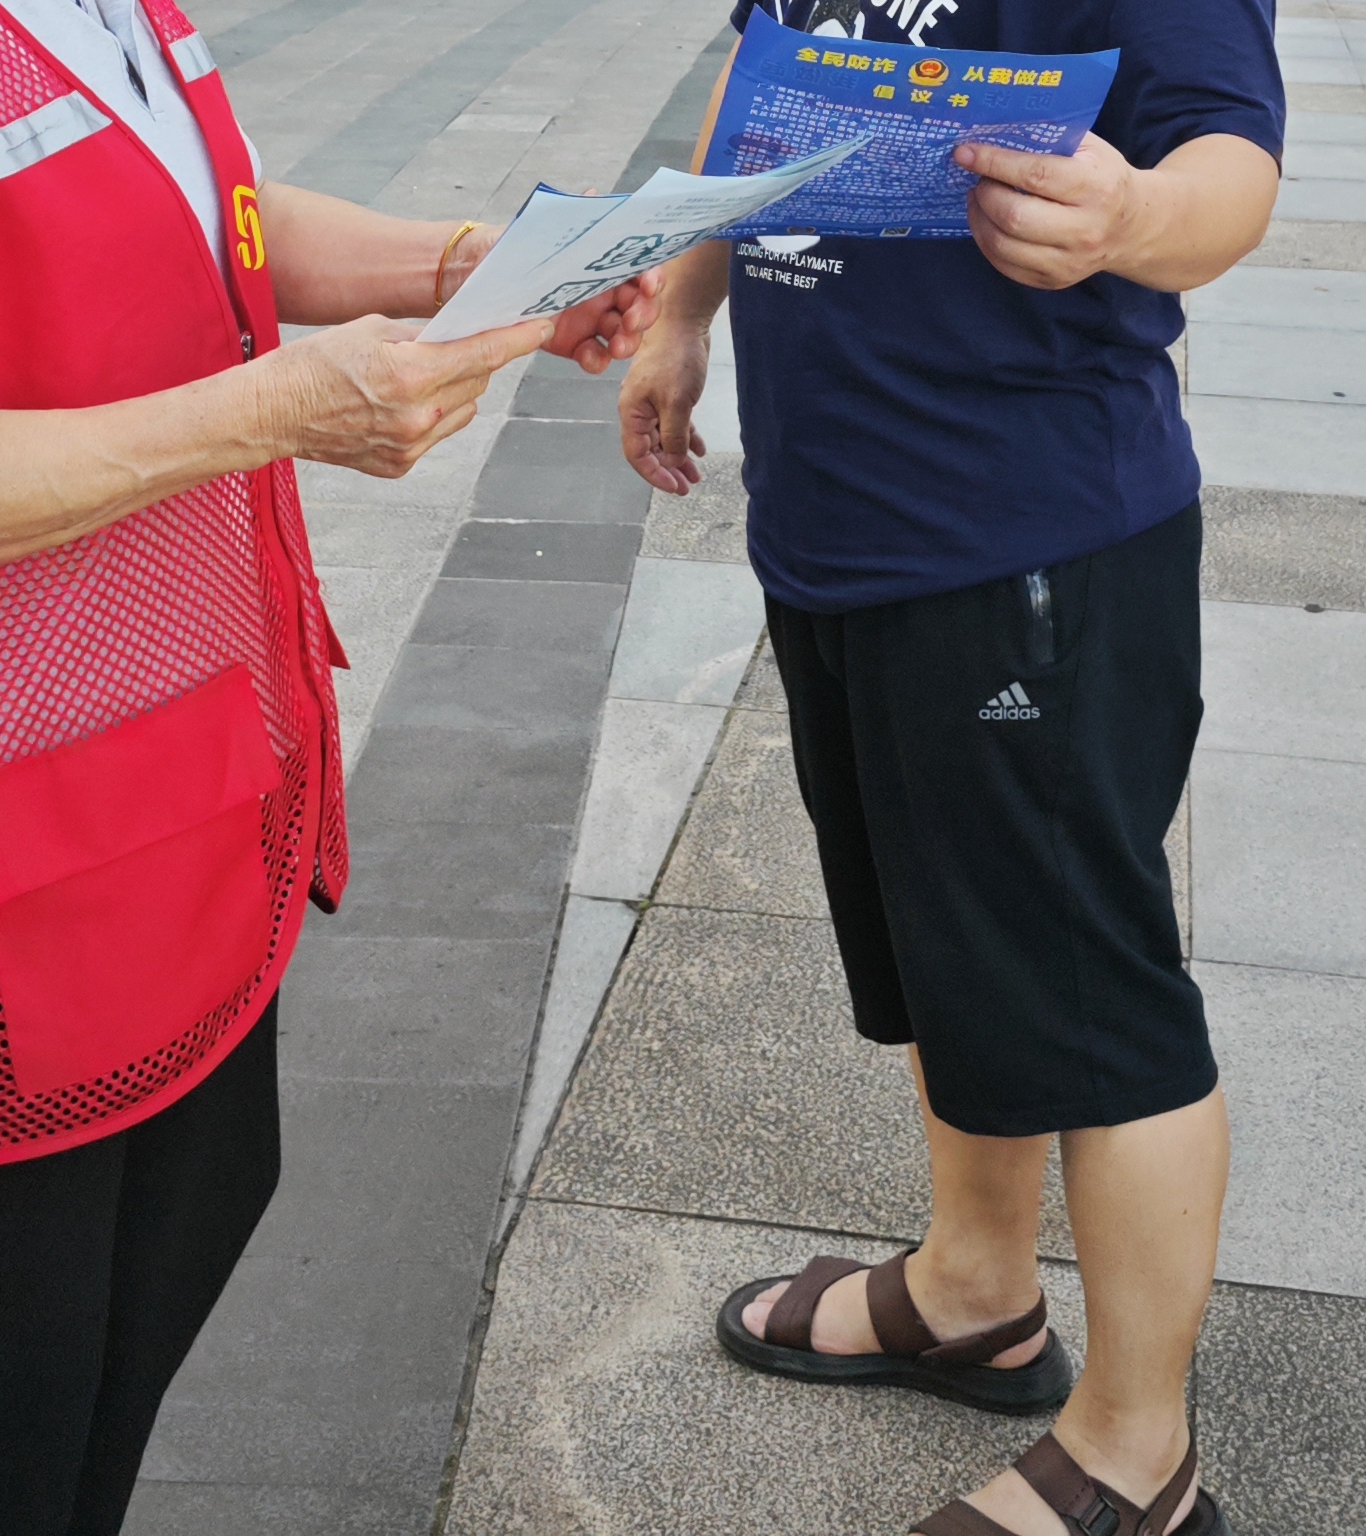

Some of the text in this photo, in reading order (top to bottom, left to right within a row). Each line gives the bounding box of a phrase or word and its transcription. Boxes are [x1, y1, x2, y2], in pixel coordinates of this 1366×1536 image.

[795, 47, 898, 73] 全民防诈
[962, 66, 1064, 87] 从我做起
[873, 84, 970, 108] 倡议书
[737, 243, 764, 259] LOOKING
[764, 248, 780, 262] FOR
[789, 251, 844, 274] PLAYMATE
[745, 264, 818, 289] YOU ARE THE BEST
[978, 706, 1041, 720] adidas
